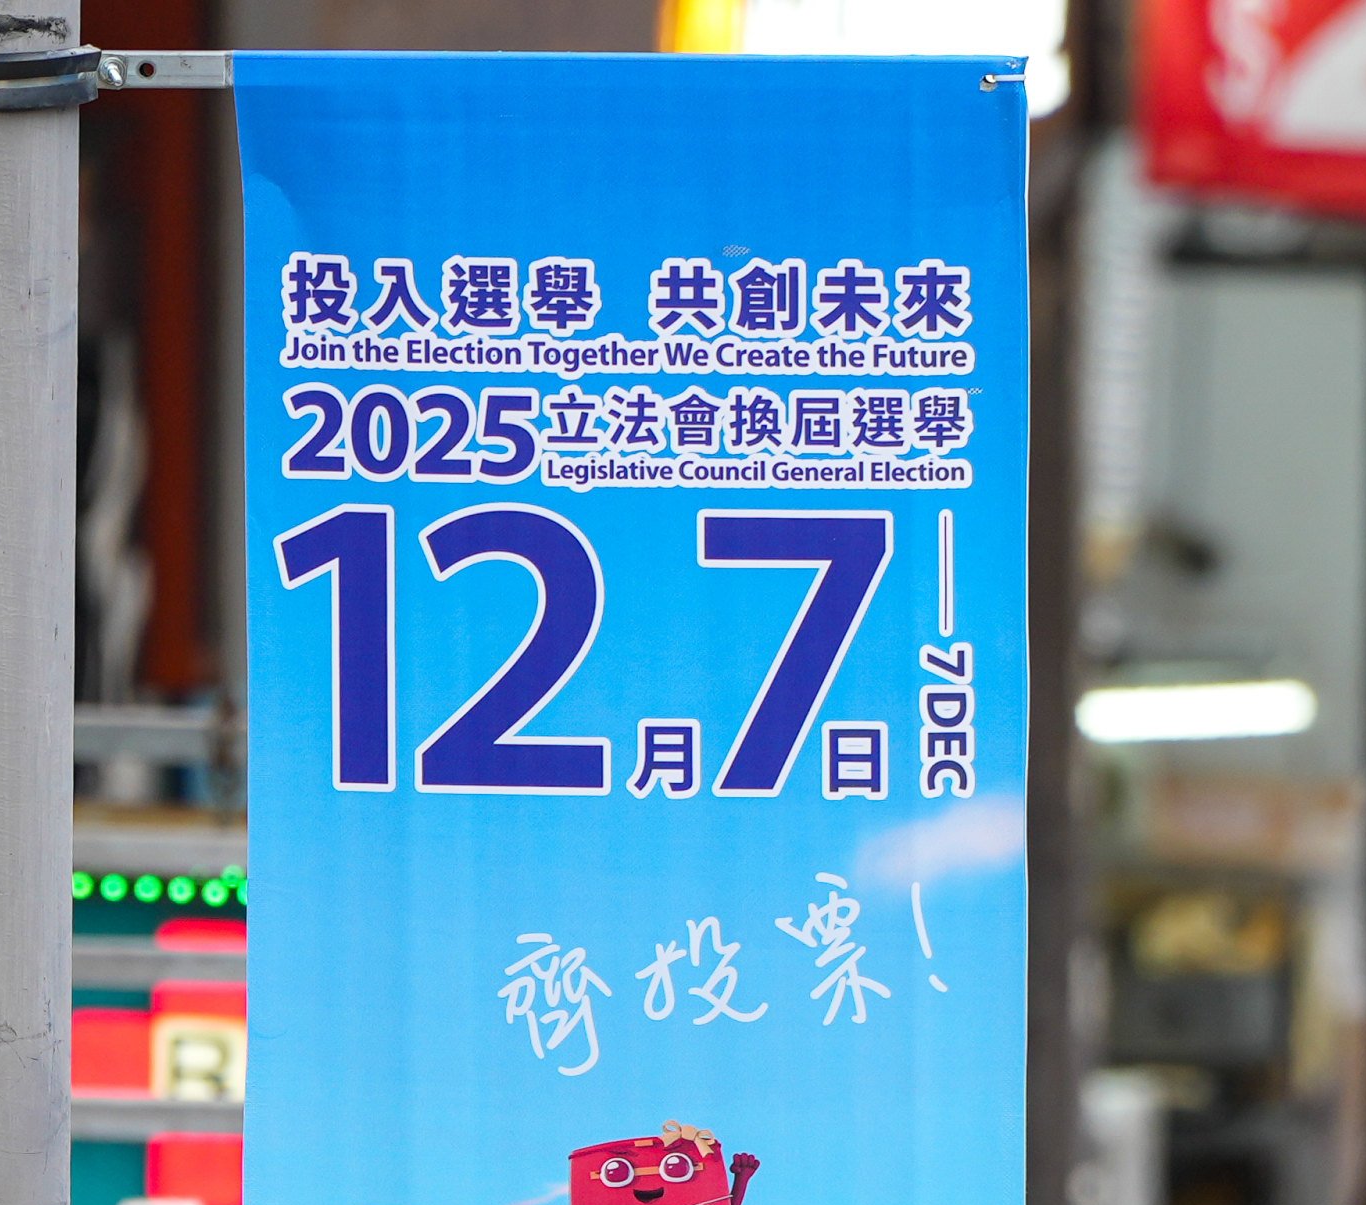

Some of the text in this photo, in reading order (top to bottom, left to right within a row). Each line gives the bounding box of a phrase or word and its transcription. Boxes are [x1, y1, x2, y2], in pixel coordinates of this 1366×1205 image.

[289, 259, 964, 333] 投入選舉 共創未來
[287, 335, 967, 373] Join the Election Together We Create the Future
[289, 390, 965, 477] 2025 立法會換屆選舉
[548, 459, 965, 485] Legislative Council General Election
[926, 649, 968, 791] 7 DEC
